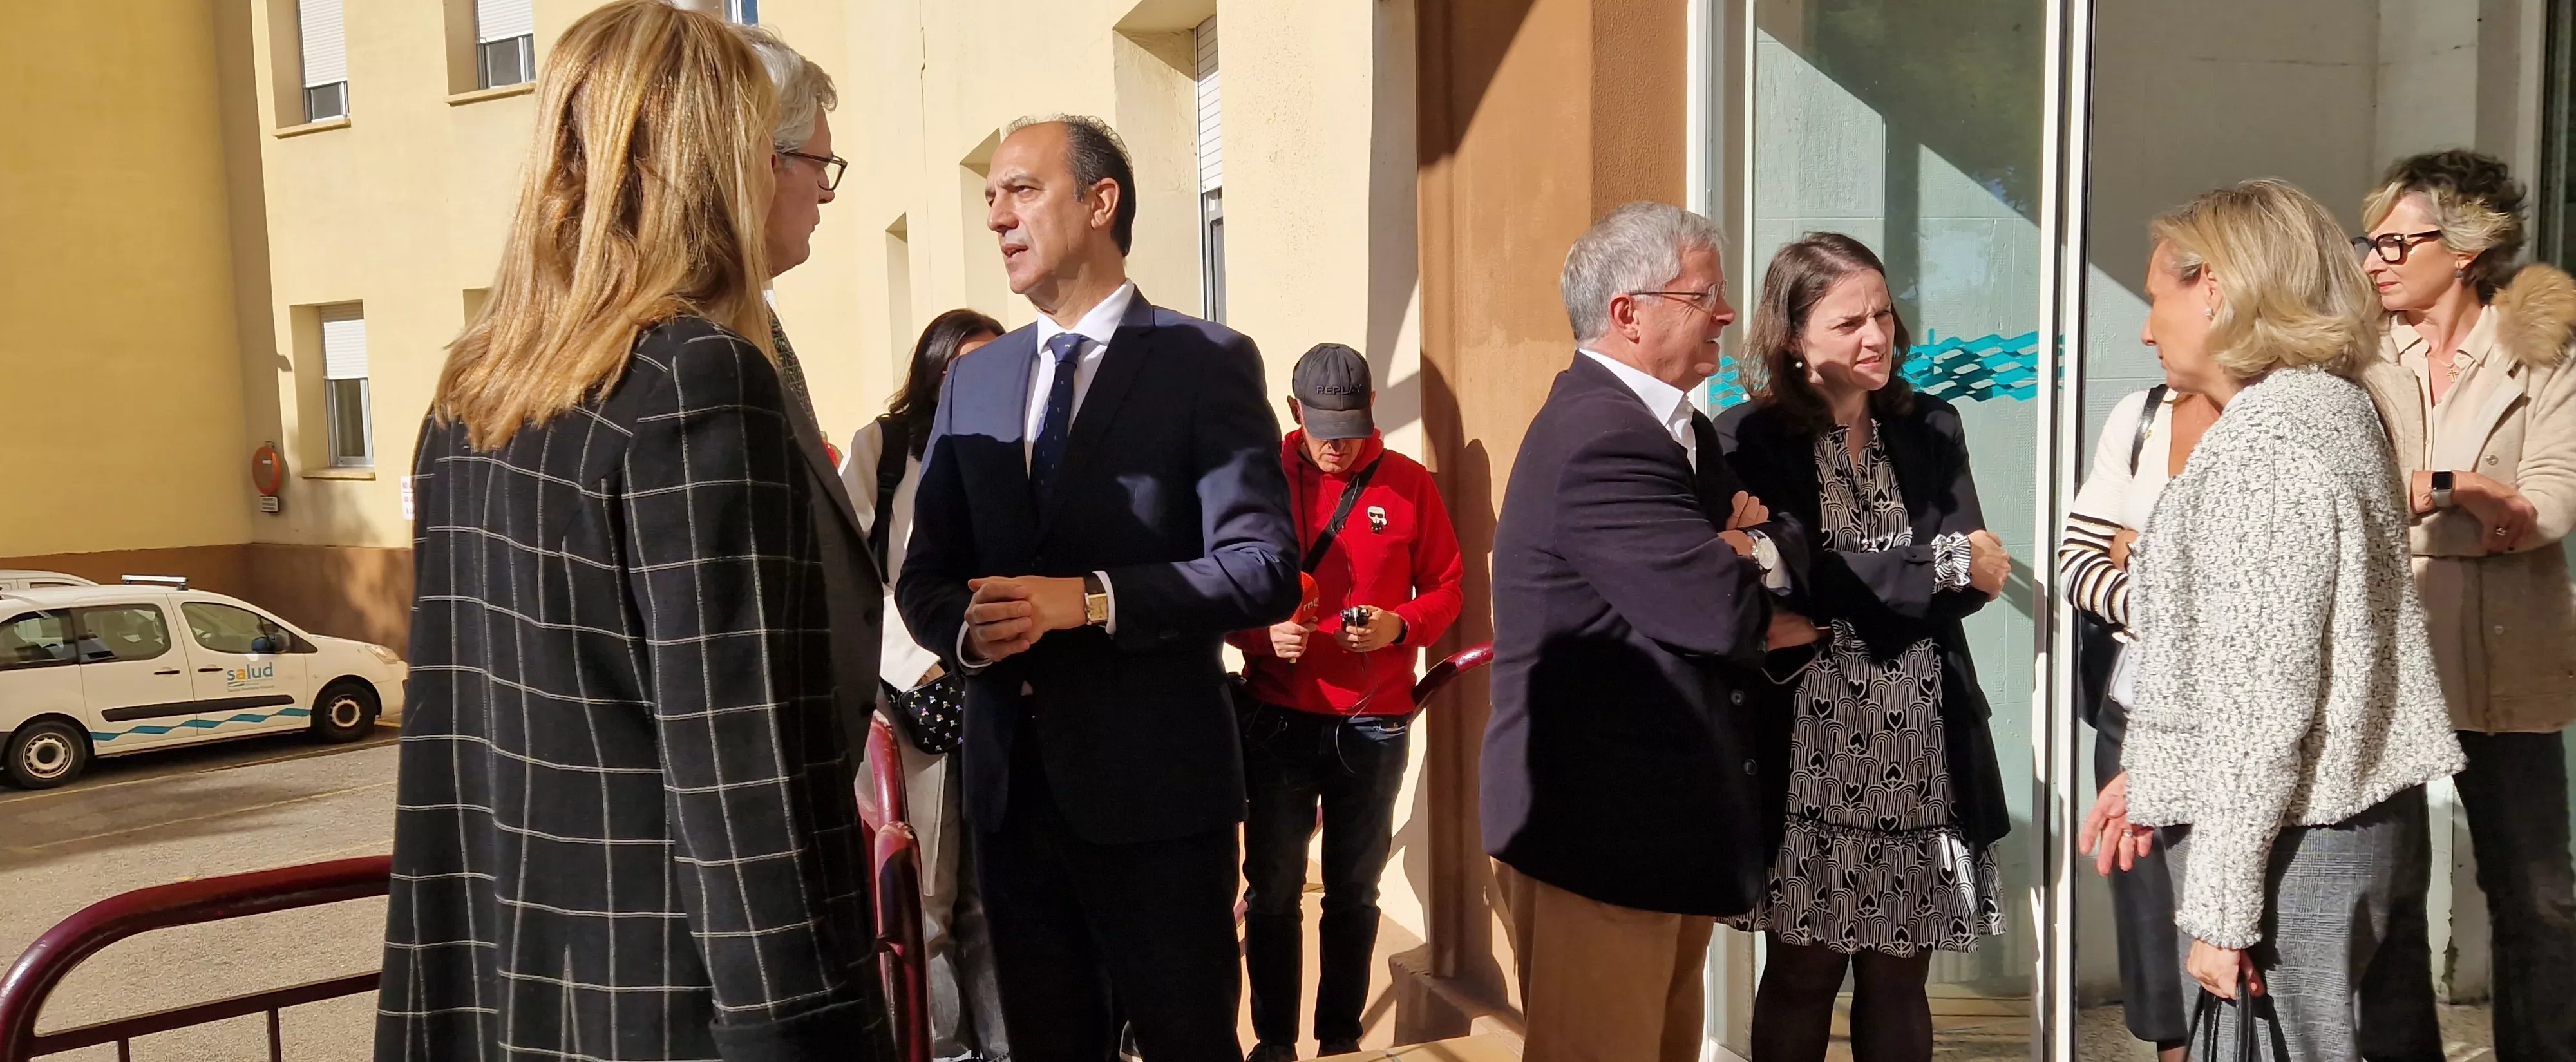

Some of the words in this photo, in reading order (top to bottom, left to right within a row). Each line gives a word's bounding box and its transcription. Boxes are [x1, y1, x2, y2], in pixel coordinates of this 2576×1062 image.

[1316, 384, 1362, 395] REPLAY
[1303, 597, 1320, 612] rne
[227, 661, 274, 681] salud
